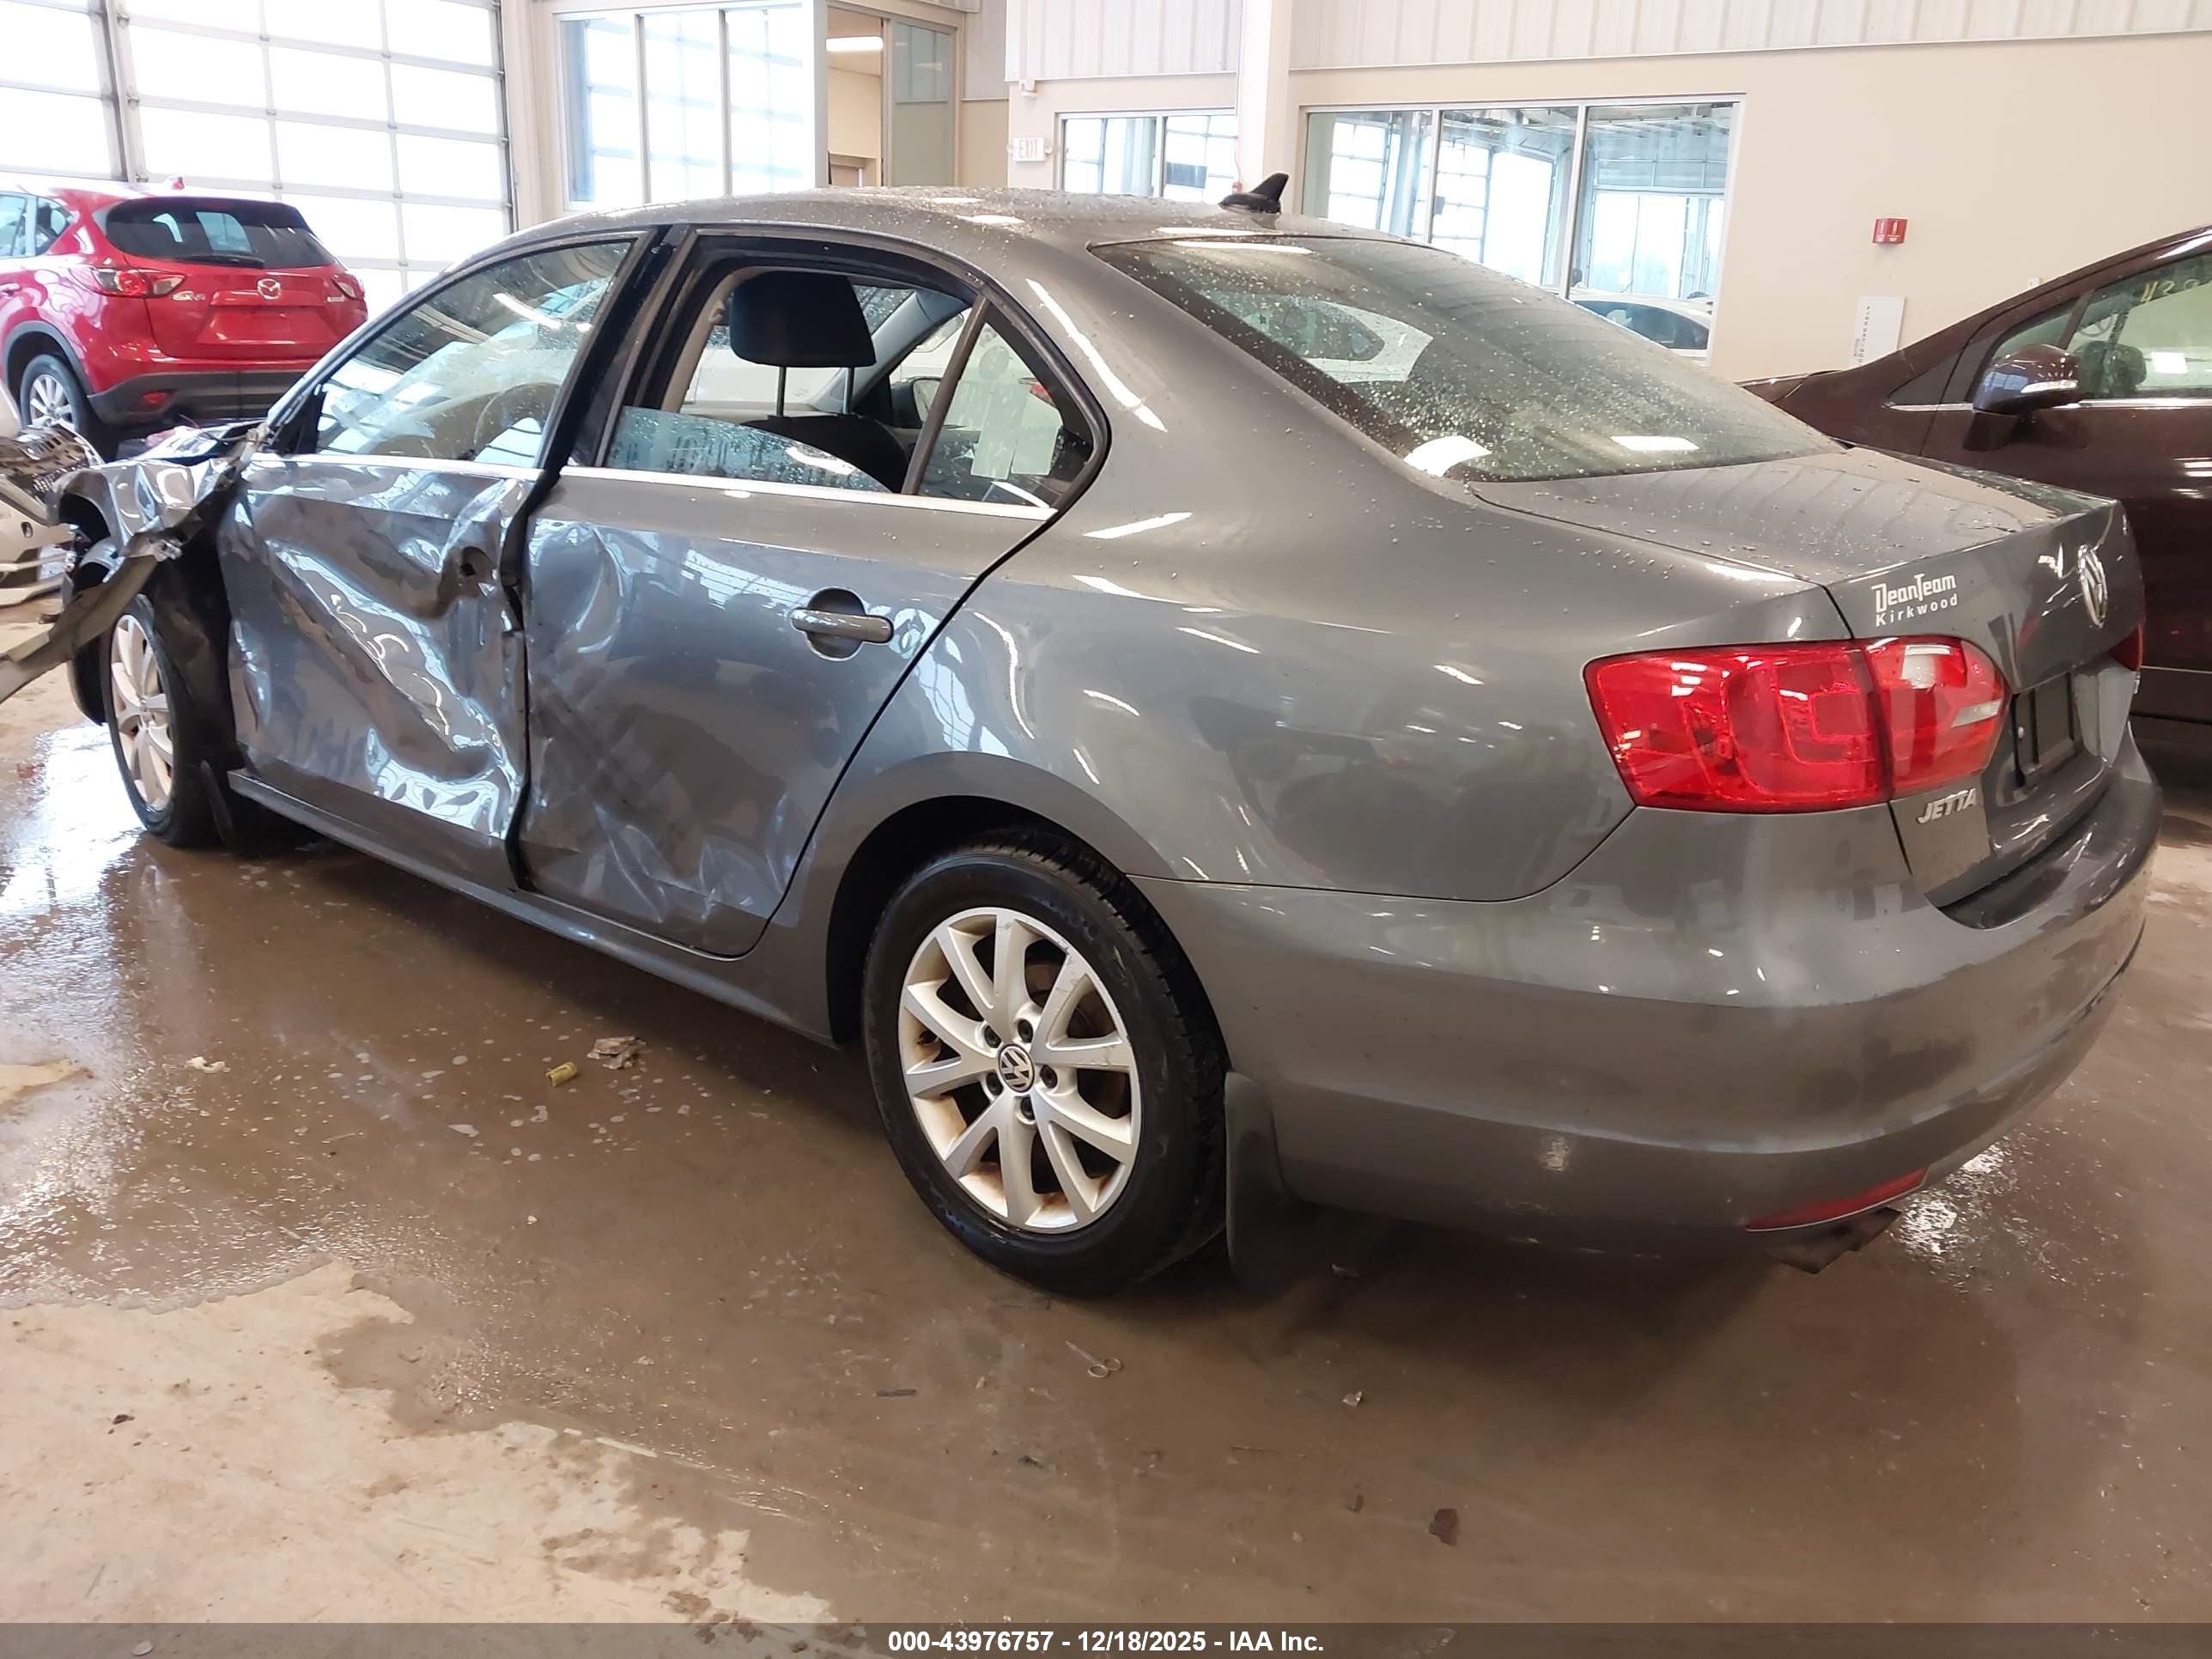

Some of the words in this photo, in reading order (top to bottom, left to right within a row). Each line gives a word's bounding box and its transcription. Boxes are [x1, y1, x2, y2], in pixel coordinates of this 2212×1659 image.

[1018, 138, 1038, 159] EXIT
[1875, 592, 1958, 628] Kirkwood
[1917, 787, 1977, 824] JETTA
